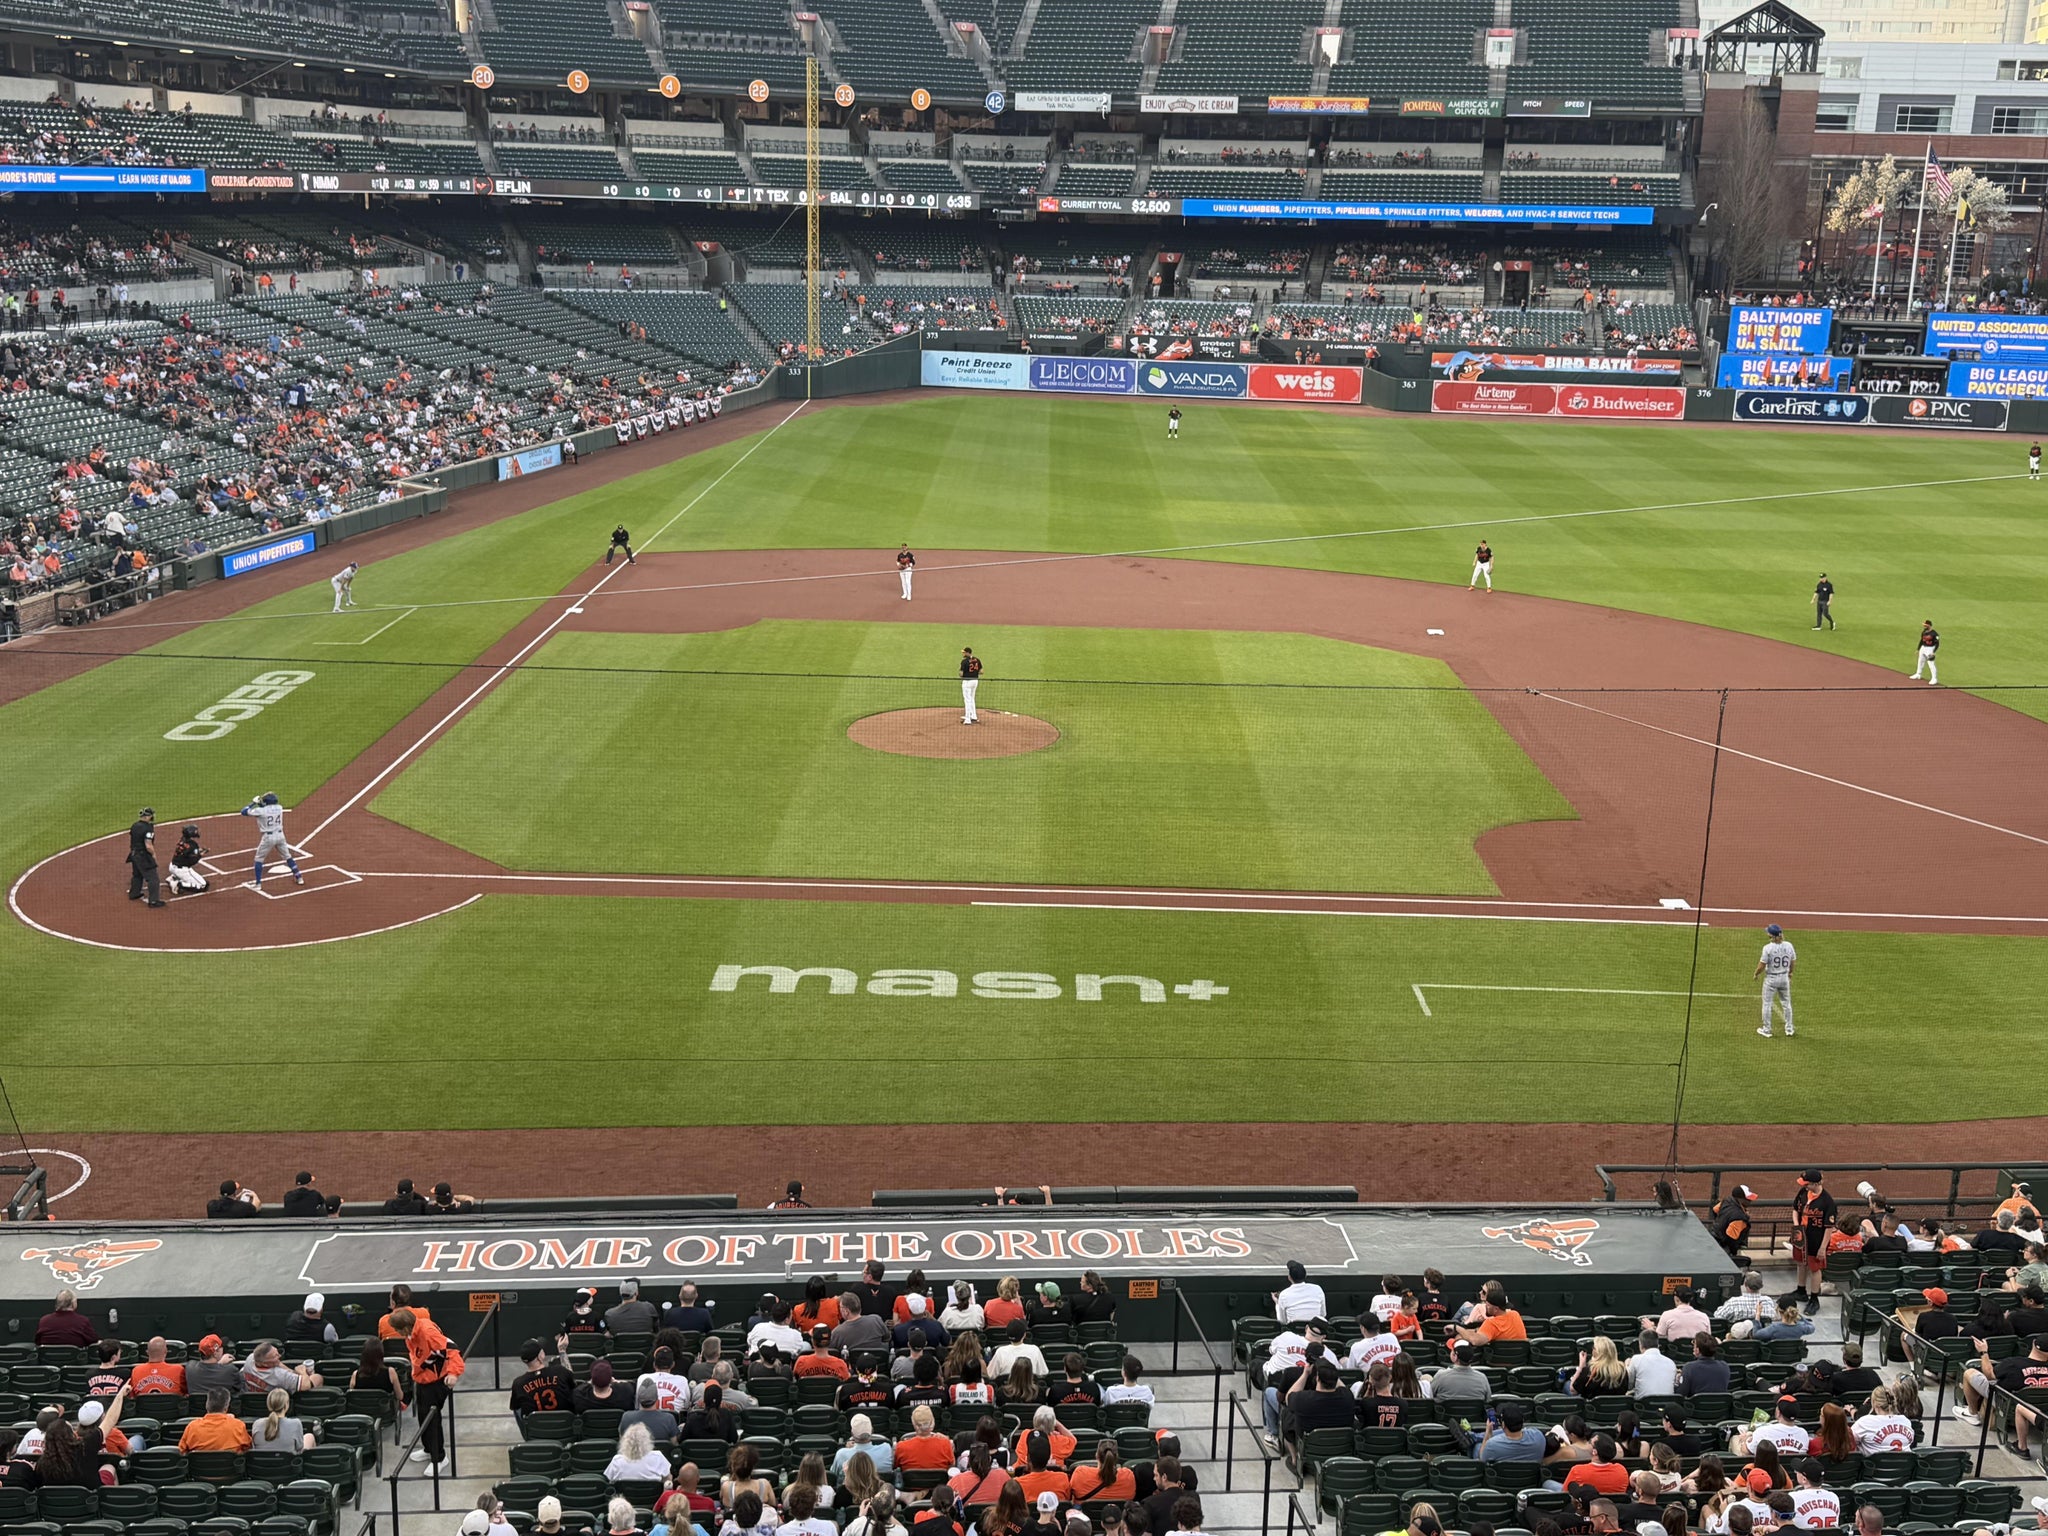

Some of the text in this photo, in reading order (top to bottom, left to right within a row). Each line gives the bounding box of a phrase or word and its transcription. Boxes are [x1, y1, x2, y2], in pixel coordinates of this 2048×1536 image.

[475, 71, 491, 83] 20
[574, 76, 582, 88] 5
[666, 80, 673, 92] 4
[752, 85, 766, 97] 22
[838, 89, 852, 102] 33
[918, 93, 924, 106] 8
[988, 96, 1002, 109] 42
[1145, 99, 1165, 109] ENJOY
[1198, 100, 1210, 110] ICE
[1211, 100, 1234, 110] CREAM
[1403, 101, 1443, 112] POMPEIAN
[1447, 100, 1499, 109] AMERICA'S #1
[1522, 100, 1585, 108] PITCH SPEED
[28, 172, 56, 184] FUTURE
[118, 174, 140, 184] LEARN
[140, 174, 159, 184] MORE
[160, 175, 168, 184] AT
[495, 180, 531, 193] EFLIN
[766, 189, 789, 202] TEX
[798, 190, 807, 202] 0
[830, 191, 870, 204] BAL 0
[946, 196, 972, 208] 6:35
[1061, 200, 1097, 209] CURRENT
[1097, 201, 1122, 210] TOTAL
[1213, 204, 1238, 212] UNION
[1239, 205, 1282, 214] PLUMBERS,
[1284, 206, 1333, 215] PIPEFITTERS,
[1335, 206, 1382, 216] PIPELINERS,
[1383, 207, 1427, 217] SPRINKLER
[1428, 208, 1462, 217] FITTERS,
[1464, 209, 1505, 218] WELDERS,
[1525, 210, 1556, 218] HVAC-R
[1557, 210, 1591, 219] SERVICE
[1593, 211, 1620, 219] TECHS
[1739, 311, 1822, 325] BALTIMORE
[1780, 325, 1802, 338] ON
[1931, 320, 1976, 332] UNITED
[1199, 340, 1235, 348] protect
[941, 356, 1013, 370] Point Breeze
[1544, 356, 1632, 371] BIRD BATH
[788, 367, 801, 376] 333
[1969, 367, 1995, 381] BIG
[959, 376, 982, 384] Reliable
[1168, 371, 1237, 387] VANDA
[1274, 370, 1335, 391] weis
[1401, 381, 1416, 389] 363
[1304, 389, 1335, 398] markets
[1474, 386, 1517, 401] Airtemp
[1697, 389, 1711, 398] 376
[1748, 397, 1821, 416] CareFirst
[1930, 401, 1971, 417] PNC
[232, 538, 304, 570] UNION PIPEFITTERS
[162, 669, 316, 741] GEICO
[266, 815, 281, 826] 24
[1773, 955, 1789, 969] 96
[1811, 1217, 1823, 1227] 35
[412, 1227, 1252, 1273] HOME OF THE ORIOLES
[523, 1375, 558, 1393] DEVILLE
[533, 1388, 558, 1411] 13
[1379, 1413, 1398, 1429] 17
[1775, 1438, 1804, 1451] COWSER
